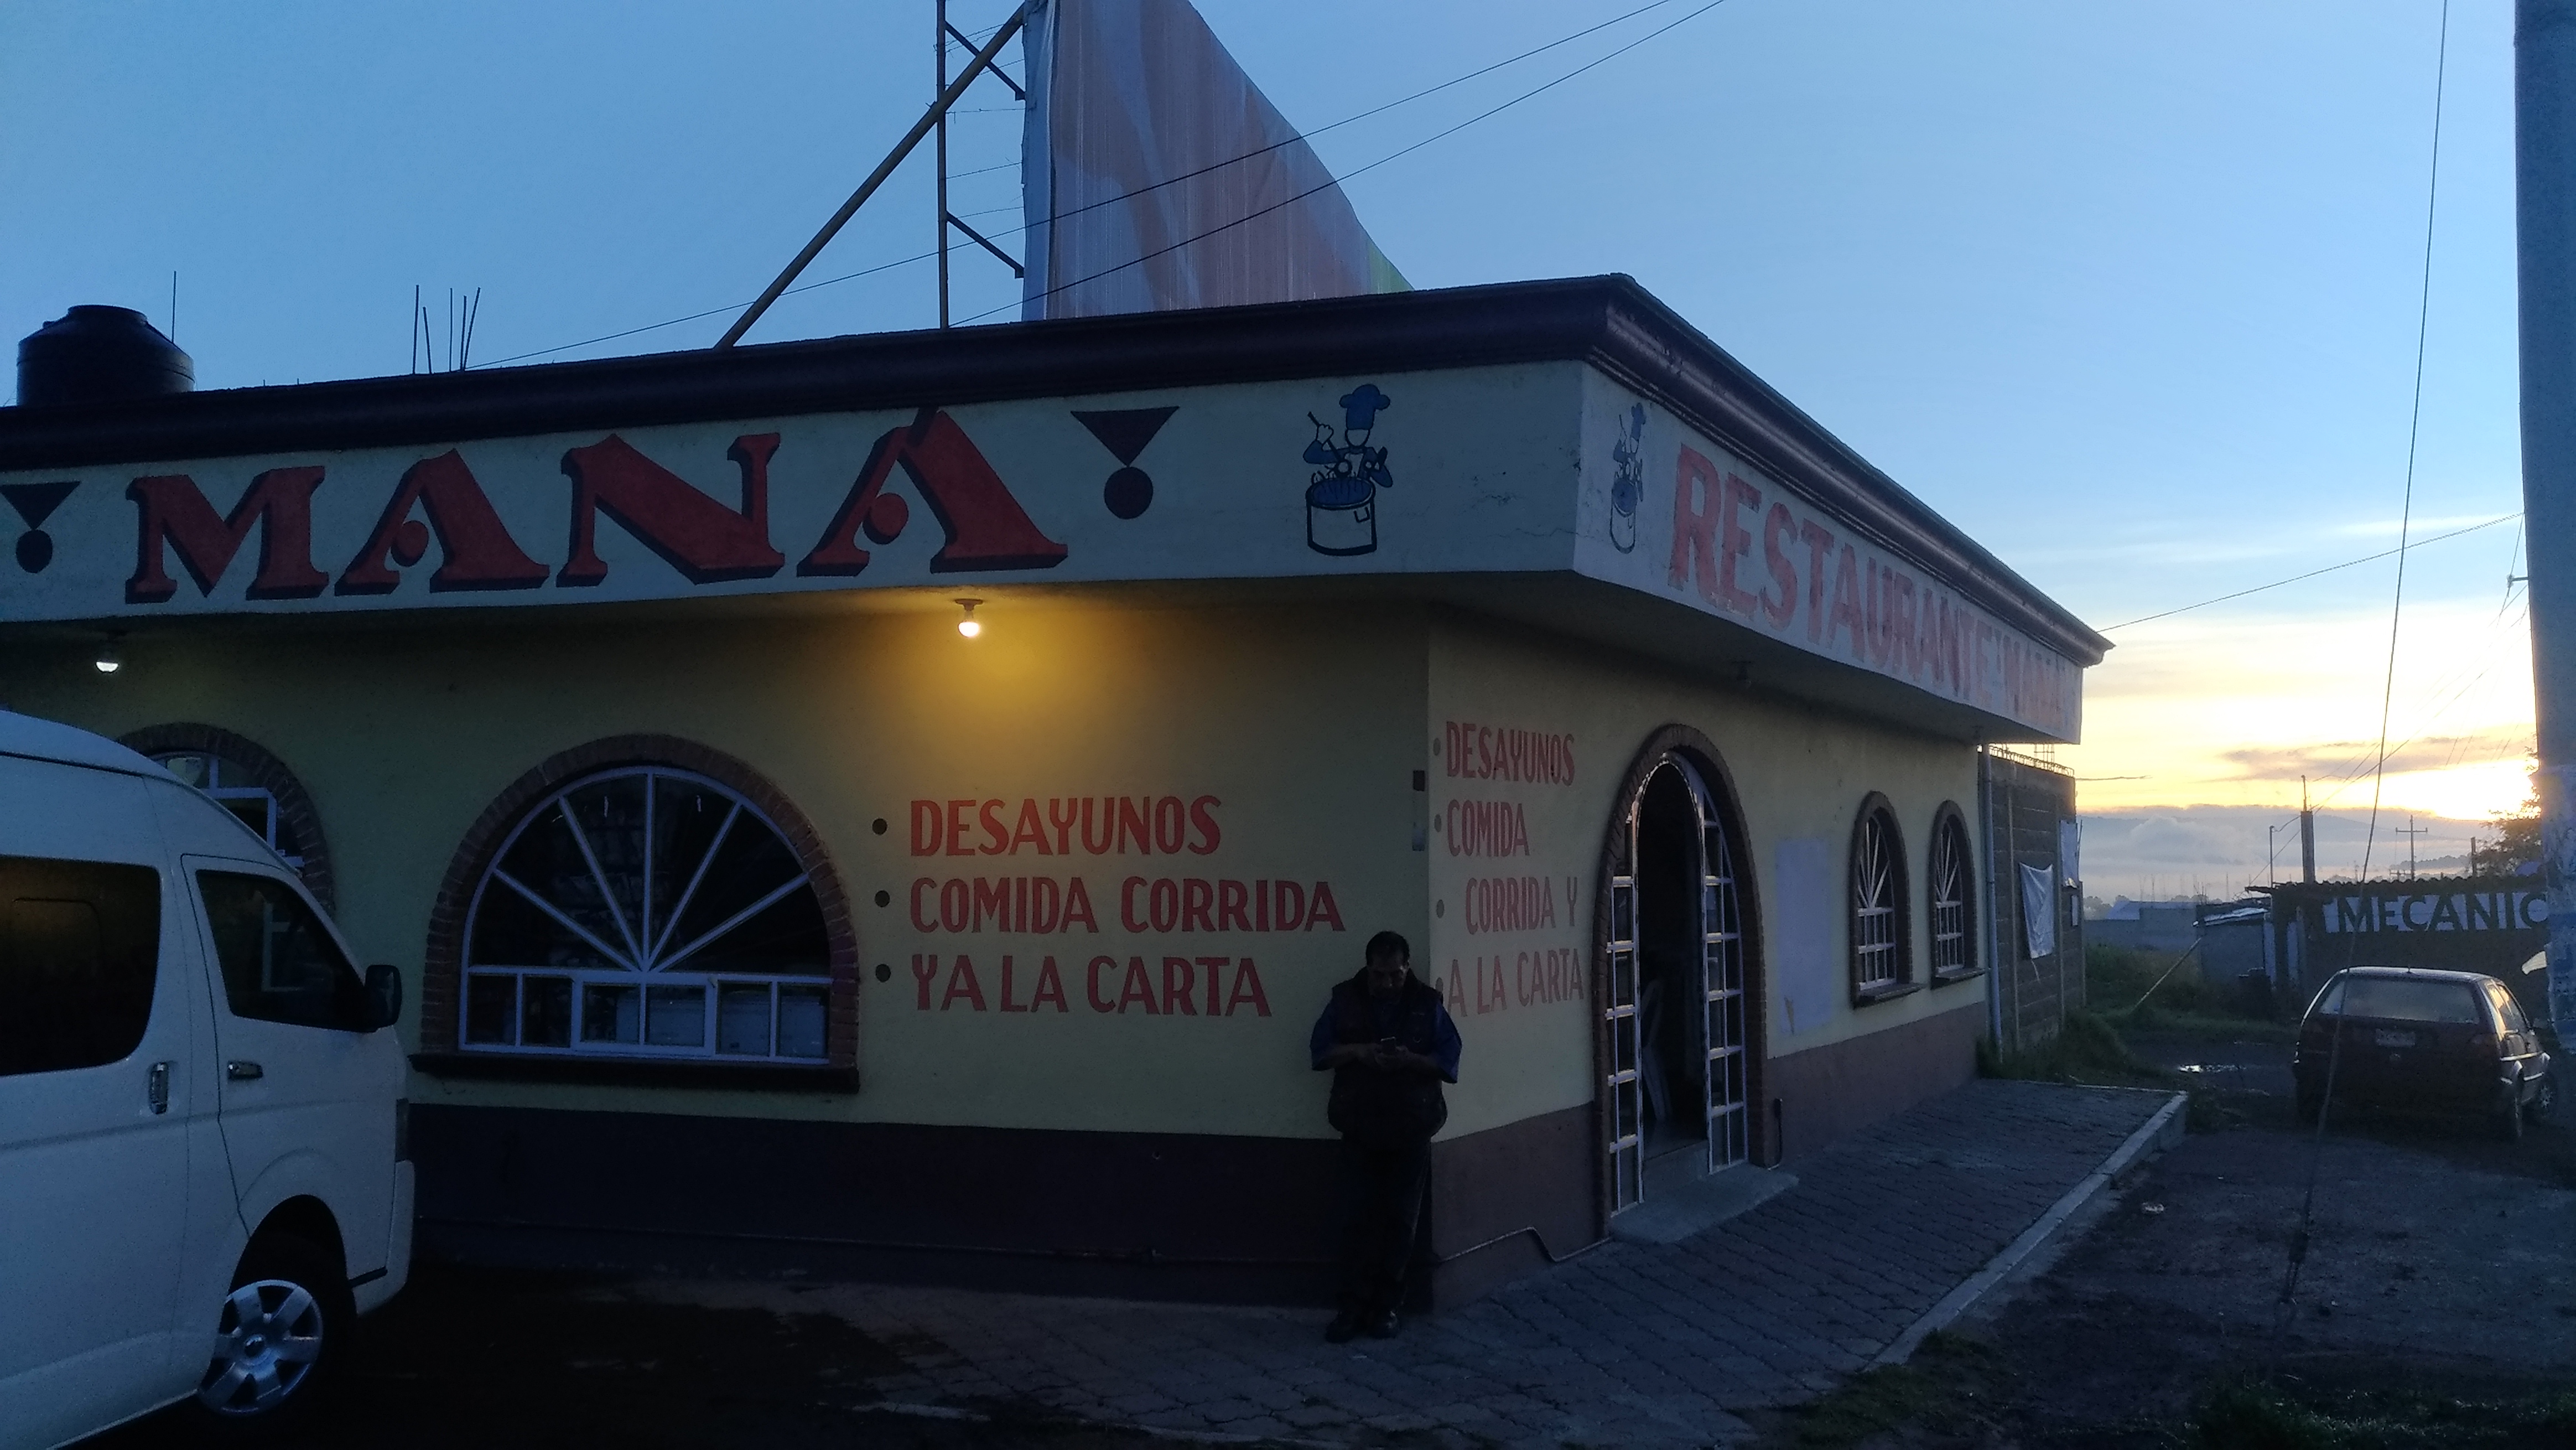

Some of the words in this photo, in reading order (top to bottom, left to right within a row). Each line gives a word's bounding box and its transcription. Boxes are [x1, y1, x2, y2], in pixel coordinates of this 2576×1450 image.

[1667, 443, 1992, 703] RESTAURANTE
[1446, 721, 1576, 786] DESAYUNOS
[910, 795, 1222, 857] DESAYUNOS
[1447, 799, 1530, 857] COMIDA
[910, 877, 1099, 934] COMIDA
[1120, 876, 1347, 933] CORRIDA
[1465, 877, 1556, 935] CORRIDA
[1566, 876, 1578, 927] Y
[1000, 955, 1069, 1013] LA
[1087, 955, 1272, 1017] CARTA
[1447, 959, 1468, 1017] A
[1477, 955, 1508, 1015] LA
[1516, 948, 1584, 1007] CARTA
